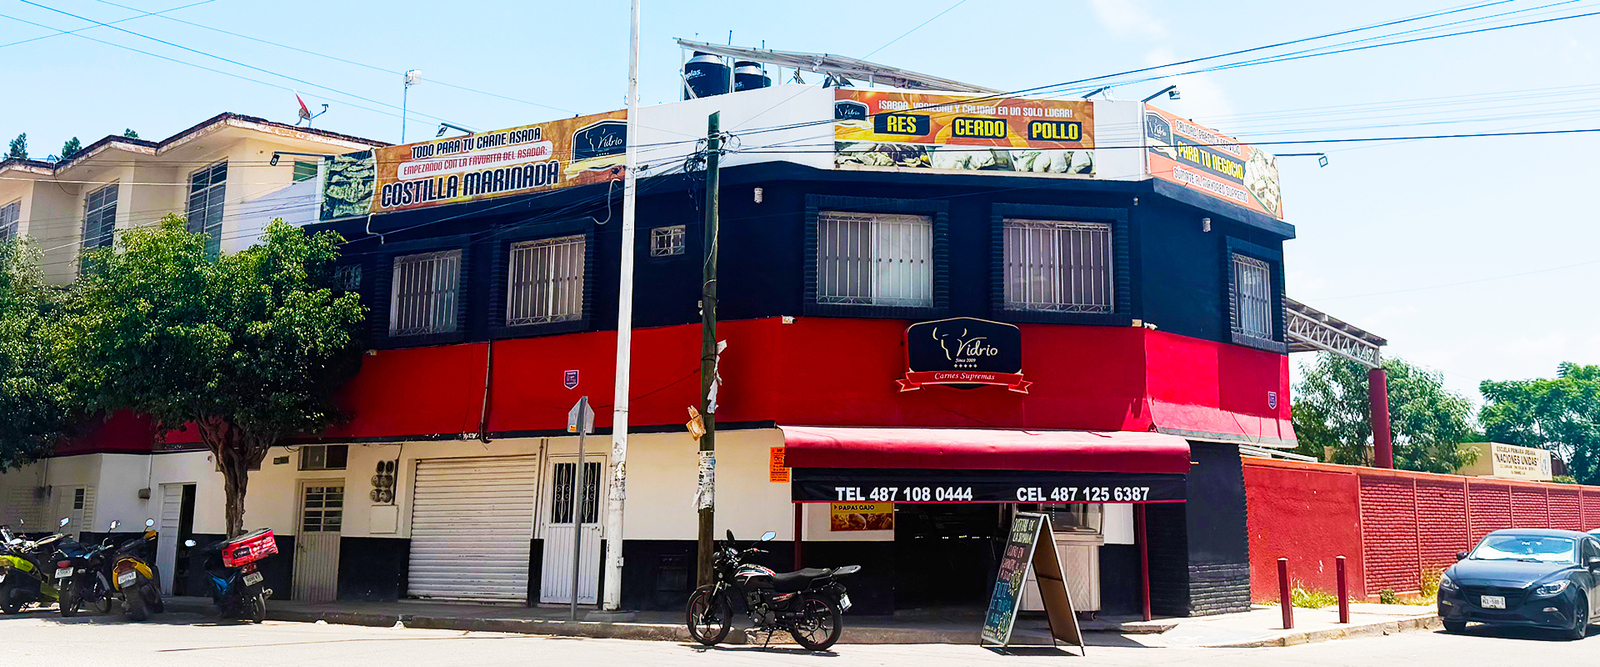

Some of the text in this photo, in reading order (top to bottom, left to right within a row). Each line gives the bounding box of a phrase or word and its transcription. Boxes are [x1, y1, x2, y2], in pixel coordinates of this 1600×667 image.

[955, 104, 961, 113] Y
[962, 105, 996, 115] CALIDAD
[998, 106, 1008, 115] EN
[1010, 107, 1021, 116] UN
[1023, 107, 1043, 117] SOLO
[1045, 108, 1073, 118] LUGAR!
[887, 115, 1078, 140] RES CERDO POLLO
[412, 127, 541, 159] TODO PARA TU CARNE ASADA
[403, 162, 443, 176] EMPEZANDO
[444, 160, 458, 170] CON
[459, 157, 467, 167] LA
[468, 153, 501, 166] FAVORITA
[503, 151, 515, 160] DEL
[1178, 141, 1244, 180] PARA TU NEGOCIO
[381, 160, 559, 207] COSTILLA MARINADA
[957, 337, 998, 356] Vidrio
[934, 372, 996, 381] Carnes Supremas
[835, 486, 973, 501] TEL 487 108 0444
[1016, 486, 1150, 501] CEL 487 125 6387
